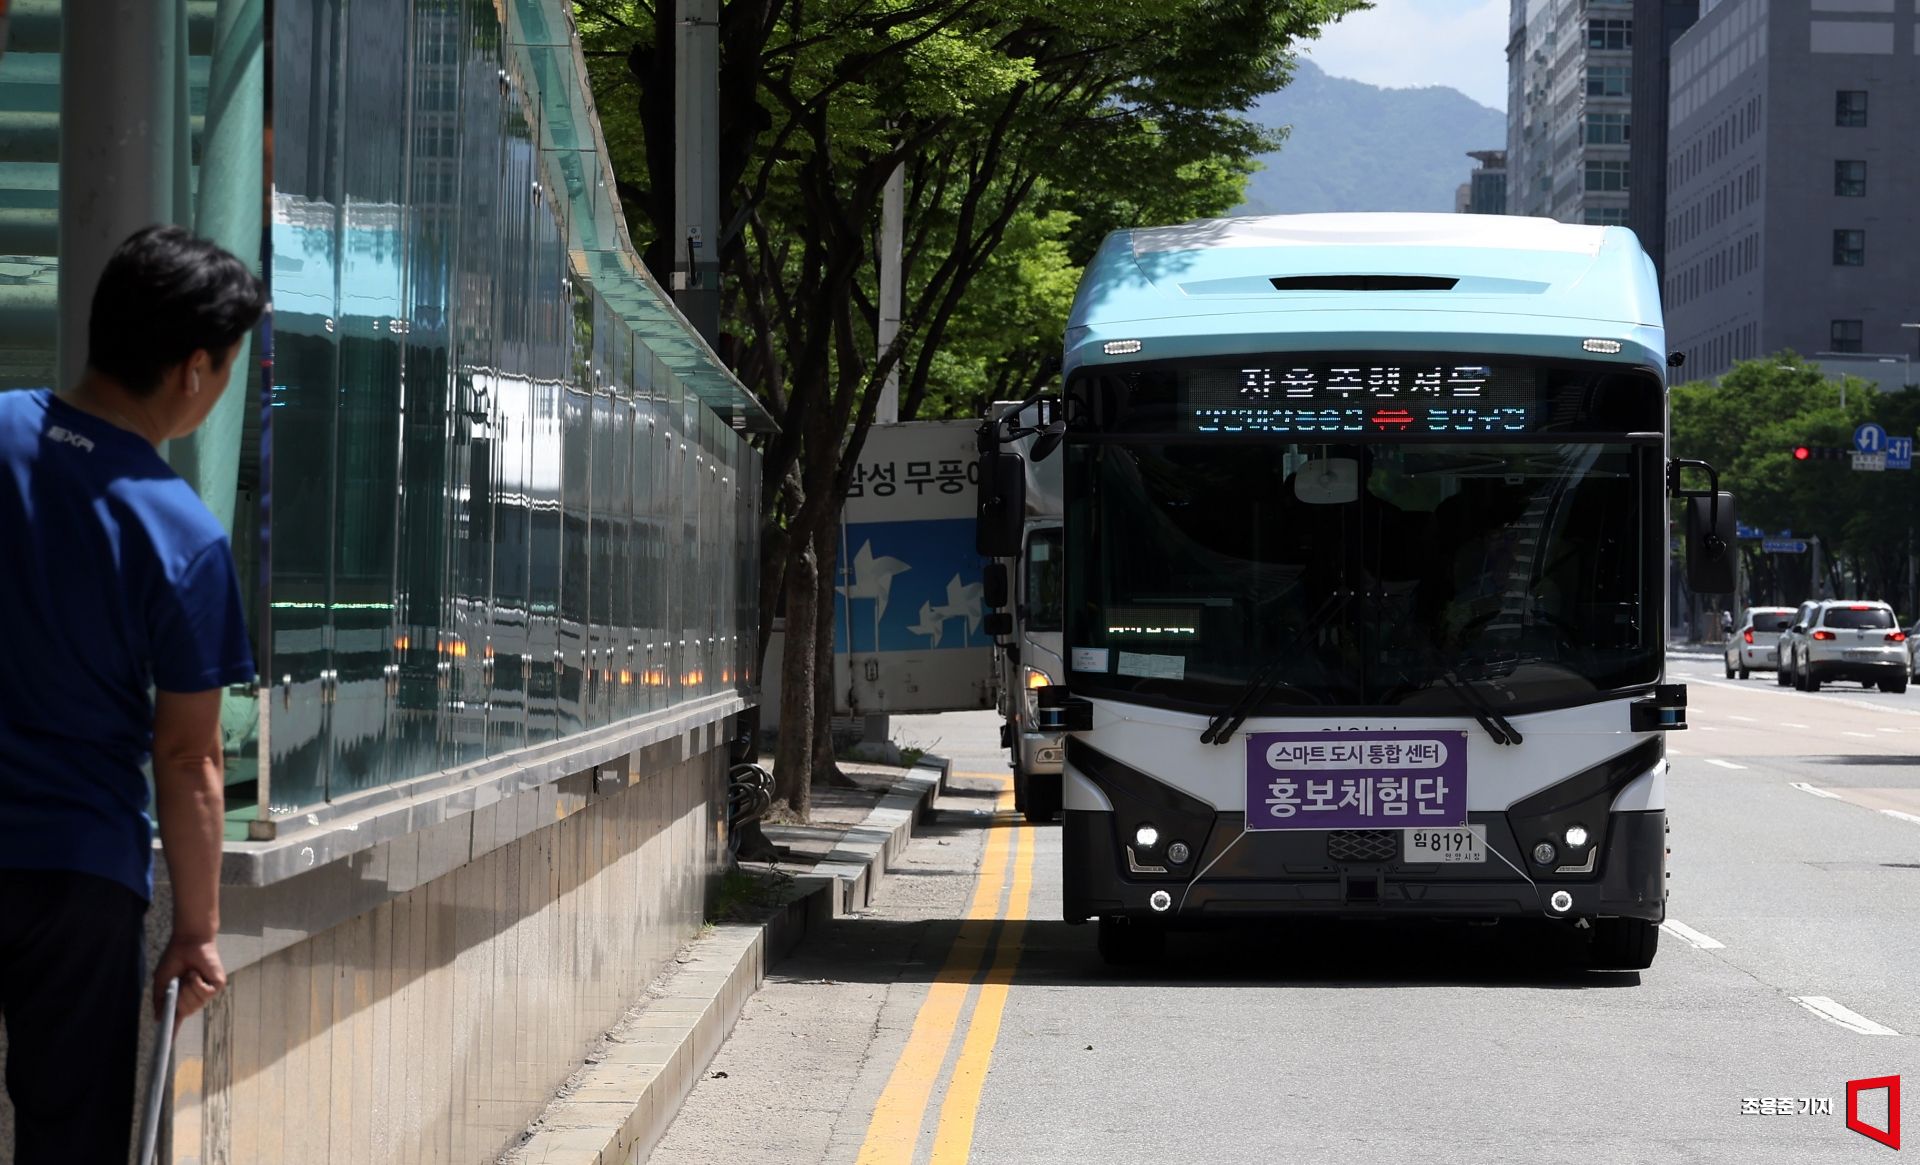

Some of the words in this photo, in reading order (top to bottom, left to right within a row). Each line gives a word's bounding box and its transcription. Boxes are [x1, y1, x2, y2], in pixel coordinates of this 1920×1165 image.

[1275, 745, 1326, 765] 스마트
[1329, 744, 1363, 764] 도시
[1367, 745, 1402, 764] 통합
[1405, 744, 1439, 763] 센터
[1265, 776, 1449, 818] 홍보체험단
[1431, 832, 1474, 851] 8191
